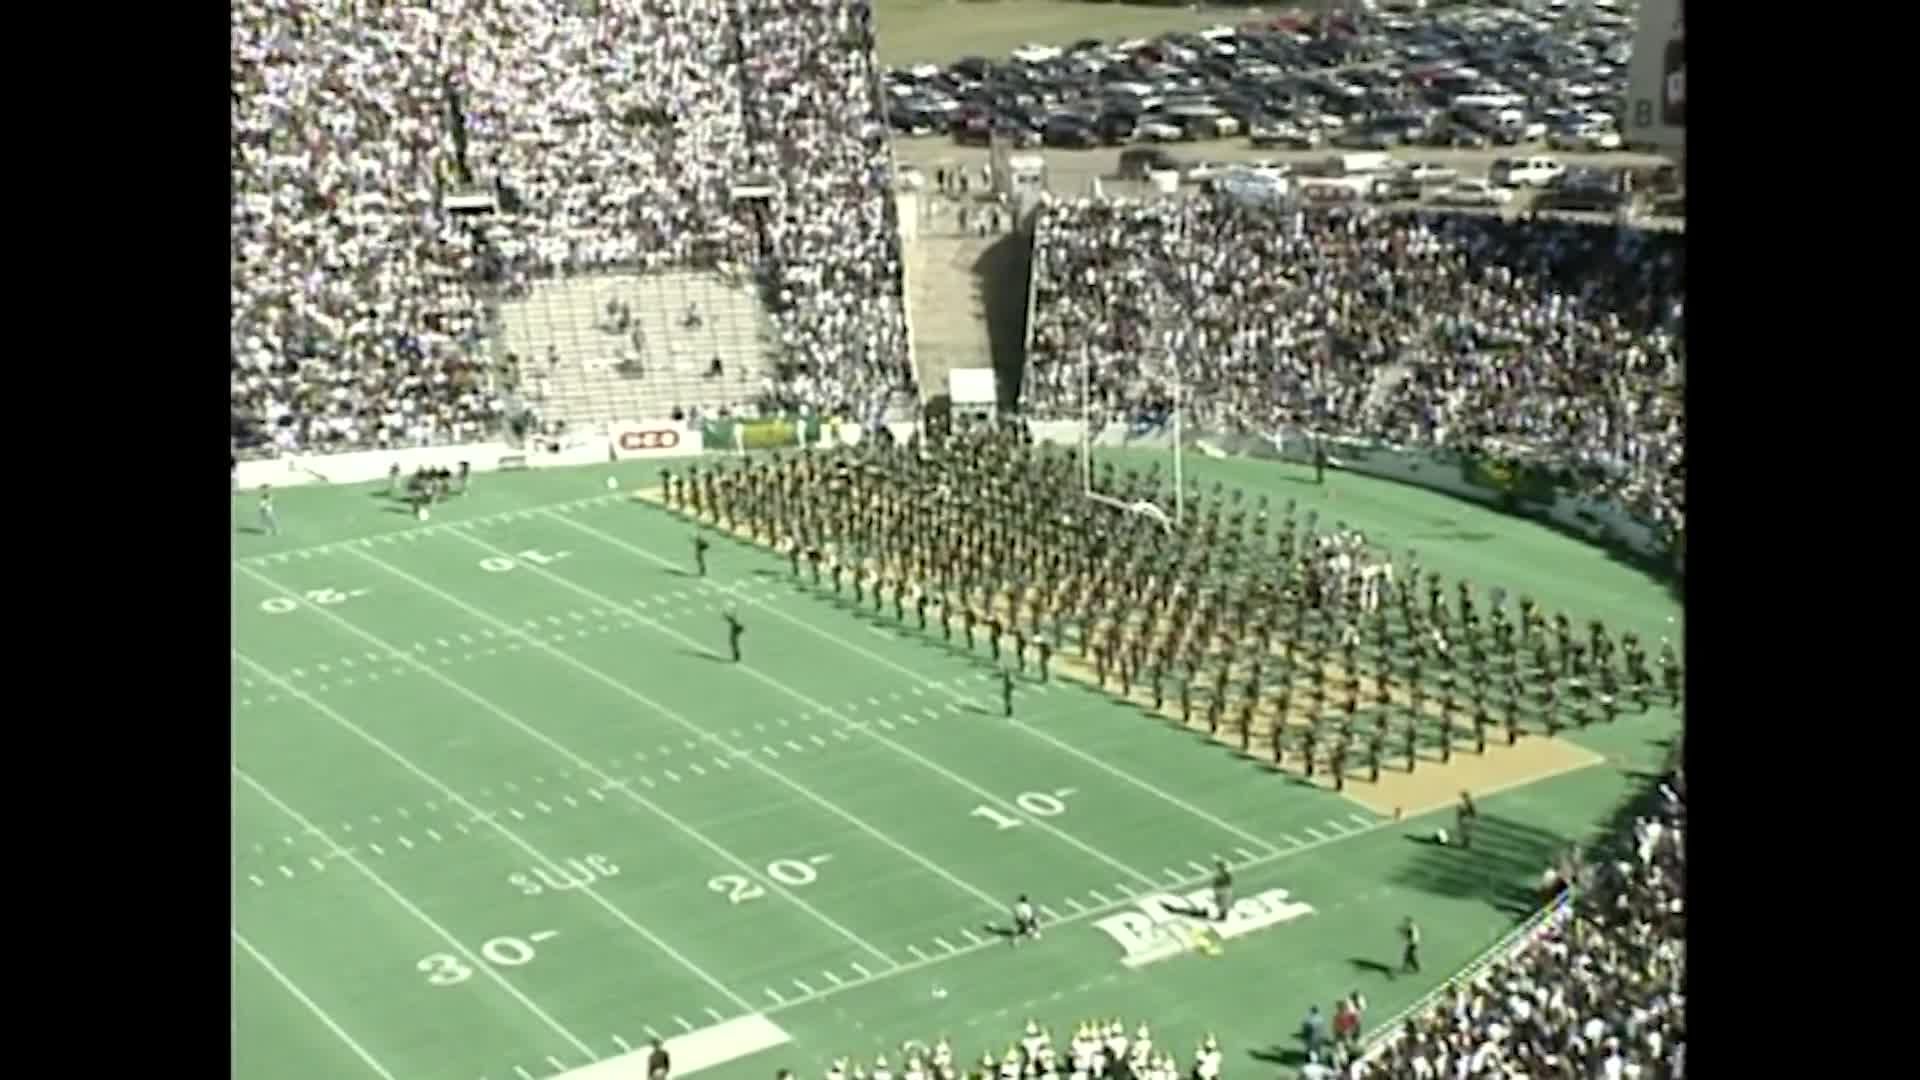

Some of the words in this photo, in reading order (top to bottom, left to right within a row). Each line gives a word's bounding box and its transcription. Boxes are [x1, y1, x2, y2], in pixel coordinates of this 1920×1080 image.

[970, 791, 1066, 831] 10
[707, 857, 818, 903] 20
[416, 935, 536, 987] 30
